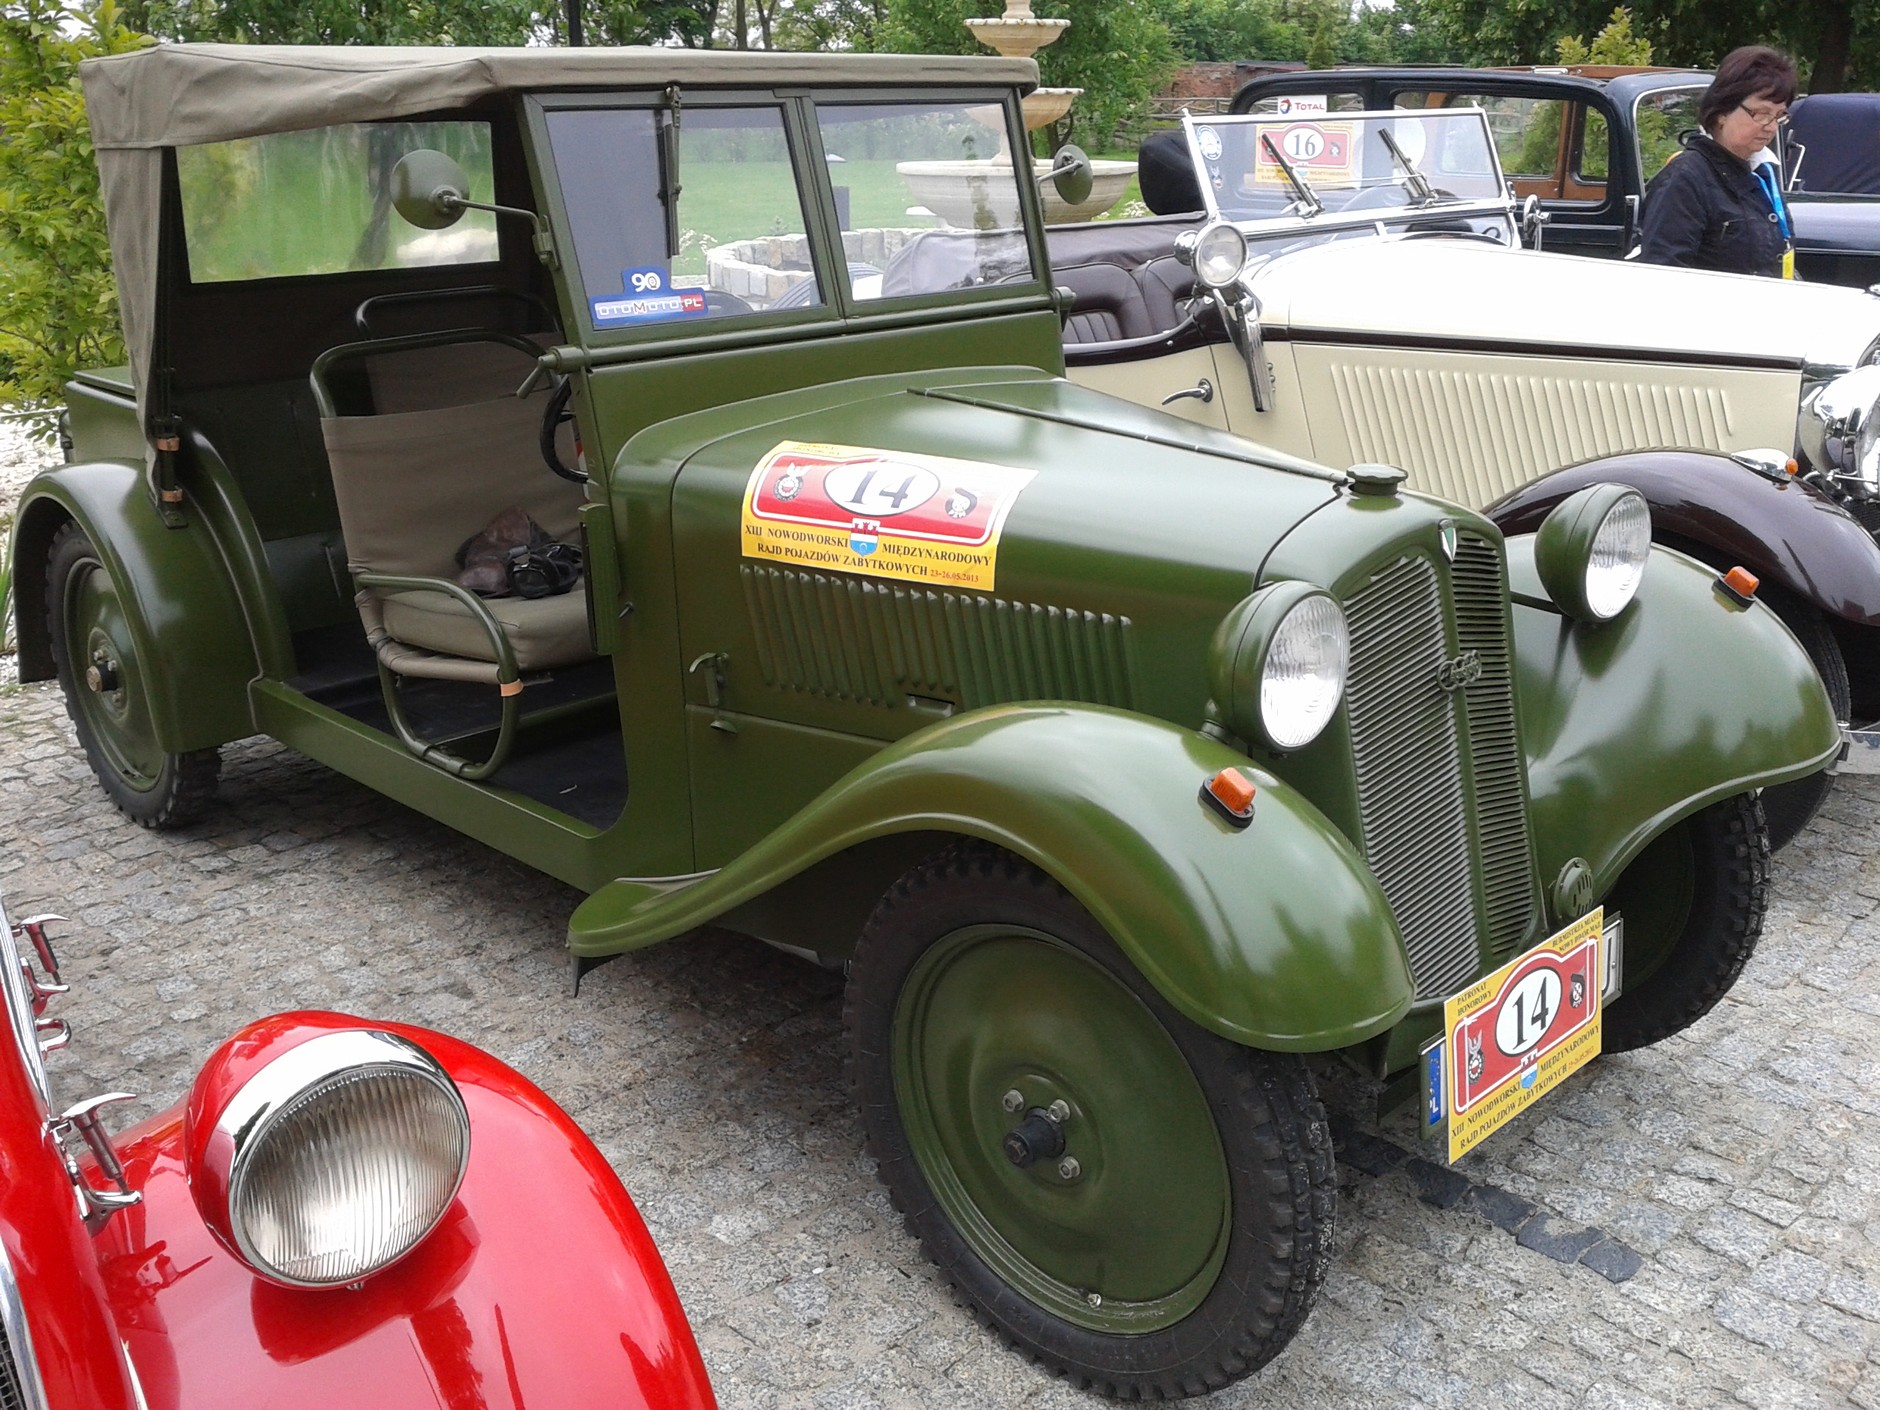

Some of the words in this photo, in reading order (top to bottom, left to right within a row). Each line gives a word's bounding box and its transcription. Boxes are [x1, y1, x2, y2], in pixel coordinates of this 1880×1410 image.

[1294, 102, 1325, 110] TOTAL
[1293, 134, 1316, 156] 16
[631, 272, 661, 292] 90
[843, 470, 917, 509] 14
[757, 543, 782, 555] RAJD
[785, 546, 842, 563] POJAZDÓW
[843, 555, 928, 576] ZABYTKOWYCH
[768, 528, 849, 548] NOWODWORSKI
[882, 543, 992, 566] MIĘDZYNARODOWY
[1457, 982, 1487, 1005] PATRONAT
[1457, 990, 1492, 1016] HONOROWY
[1512, 976, 1549, 1050] 14
[1452, 1122, 1465, 1139] XIII
[1467, 1081, 1521, 1126] NOWODWORSKI
[1540, 1024, 1600, 1073] MIĘDZYNARODOWY
[1460, 1129, 1479, 1149] RAJD
[1480, 1103, 1516, 1135] POJAZDÓW
[1517, 1064, 1568, 1107] ZABYTKOWYCH
